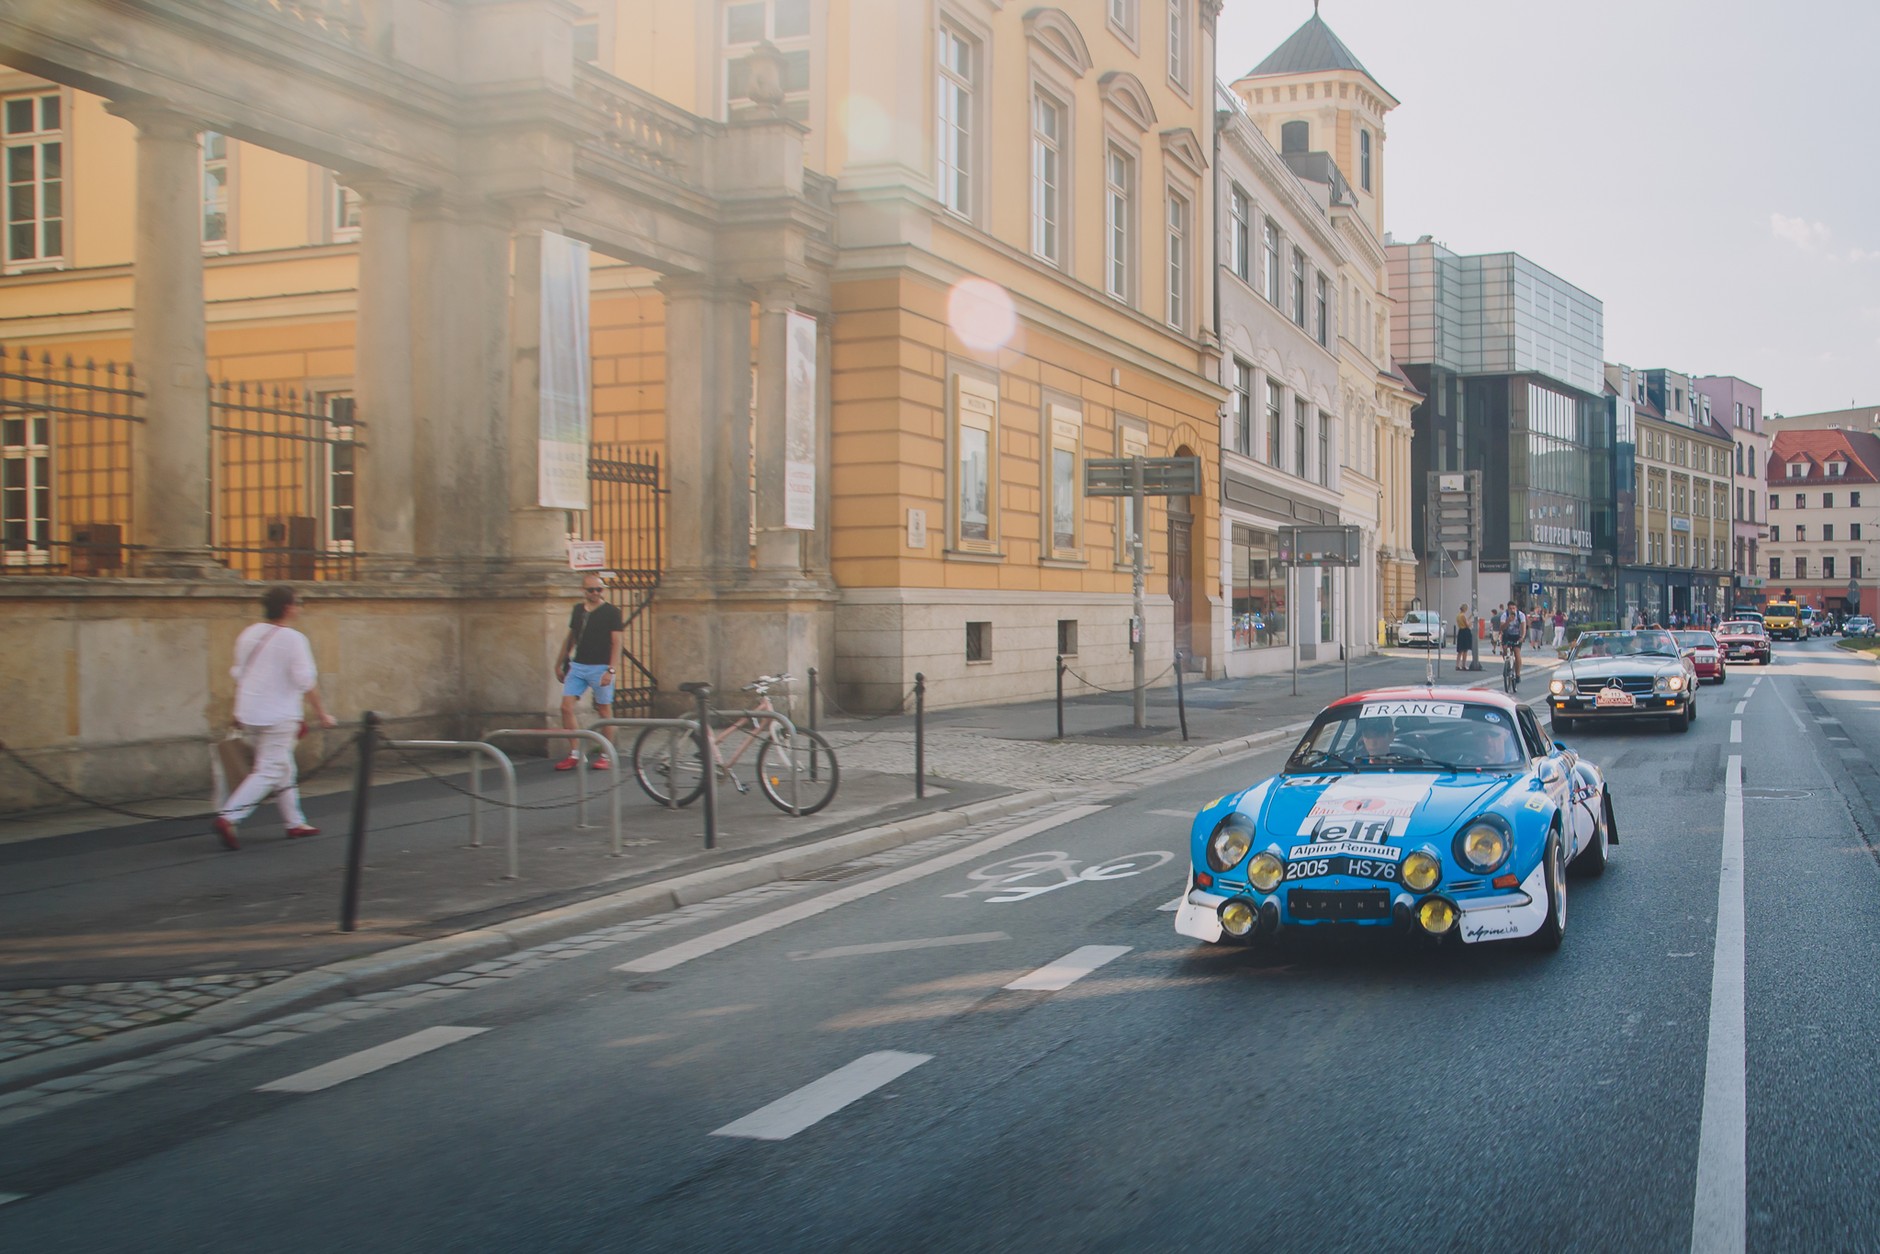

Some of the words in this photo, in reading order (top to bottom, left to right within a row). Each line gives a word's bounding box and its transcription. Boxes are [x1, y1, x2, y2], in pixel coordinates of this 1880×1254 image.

[1571, 529, 1592, 549] HOTEL
[1531, 583, 1541, 594] P
[1363, 704, 1460, 716] FRANCE
[1320, 820, 1384, 841] elf
[1294, 845, 1336, 856] Alpine
[1340, 843, 1396, 857] Renault
[1286, 859, 1329, 880] 2005
